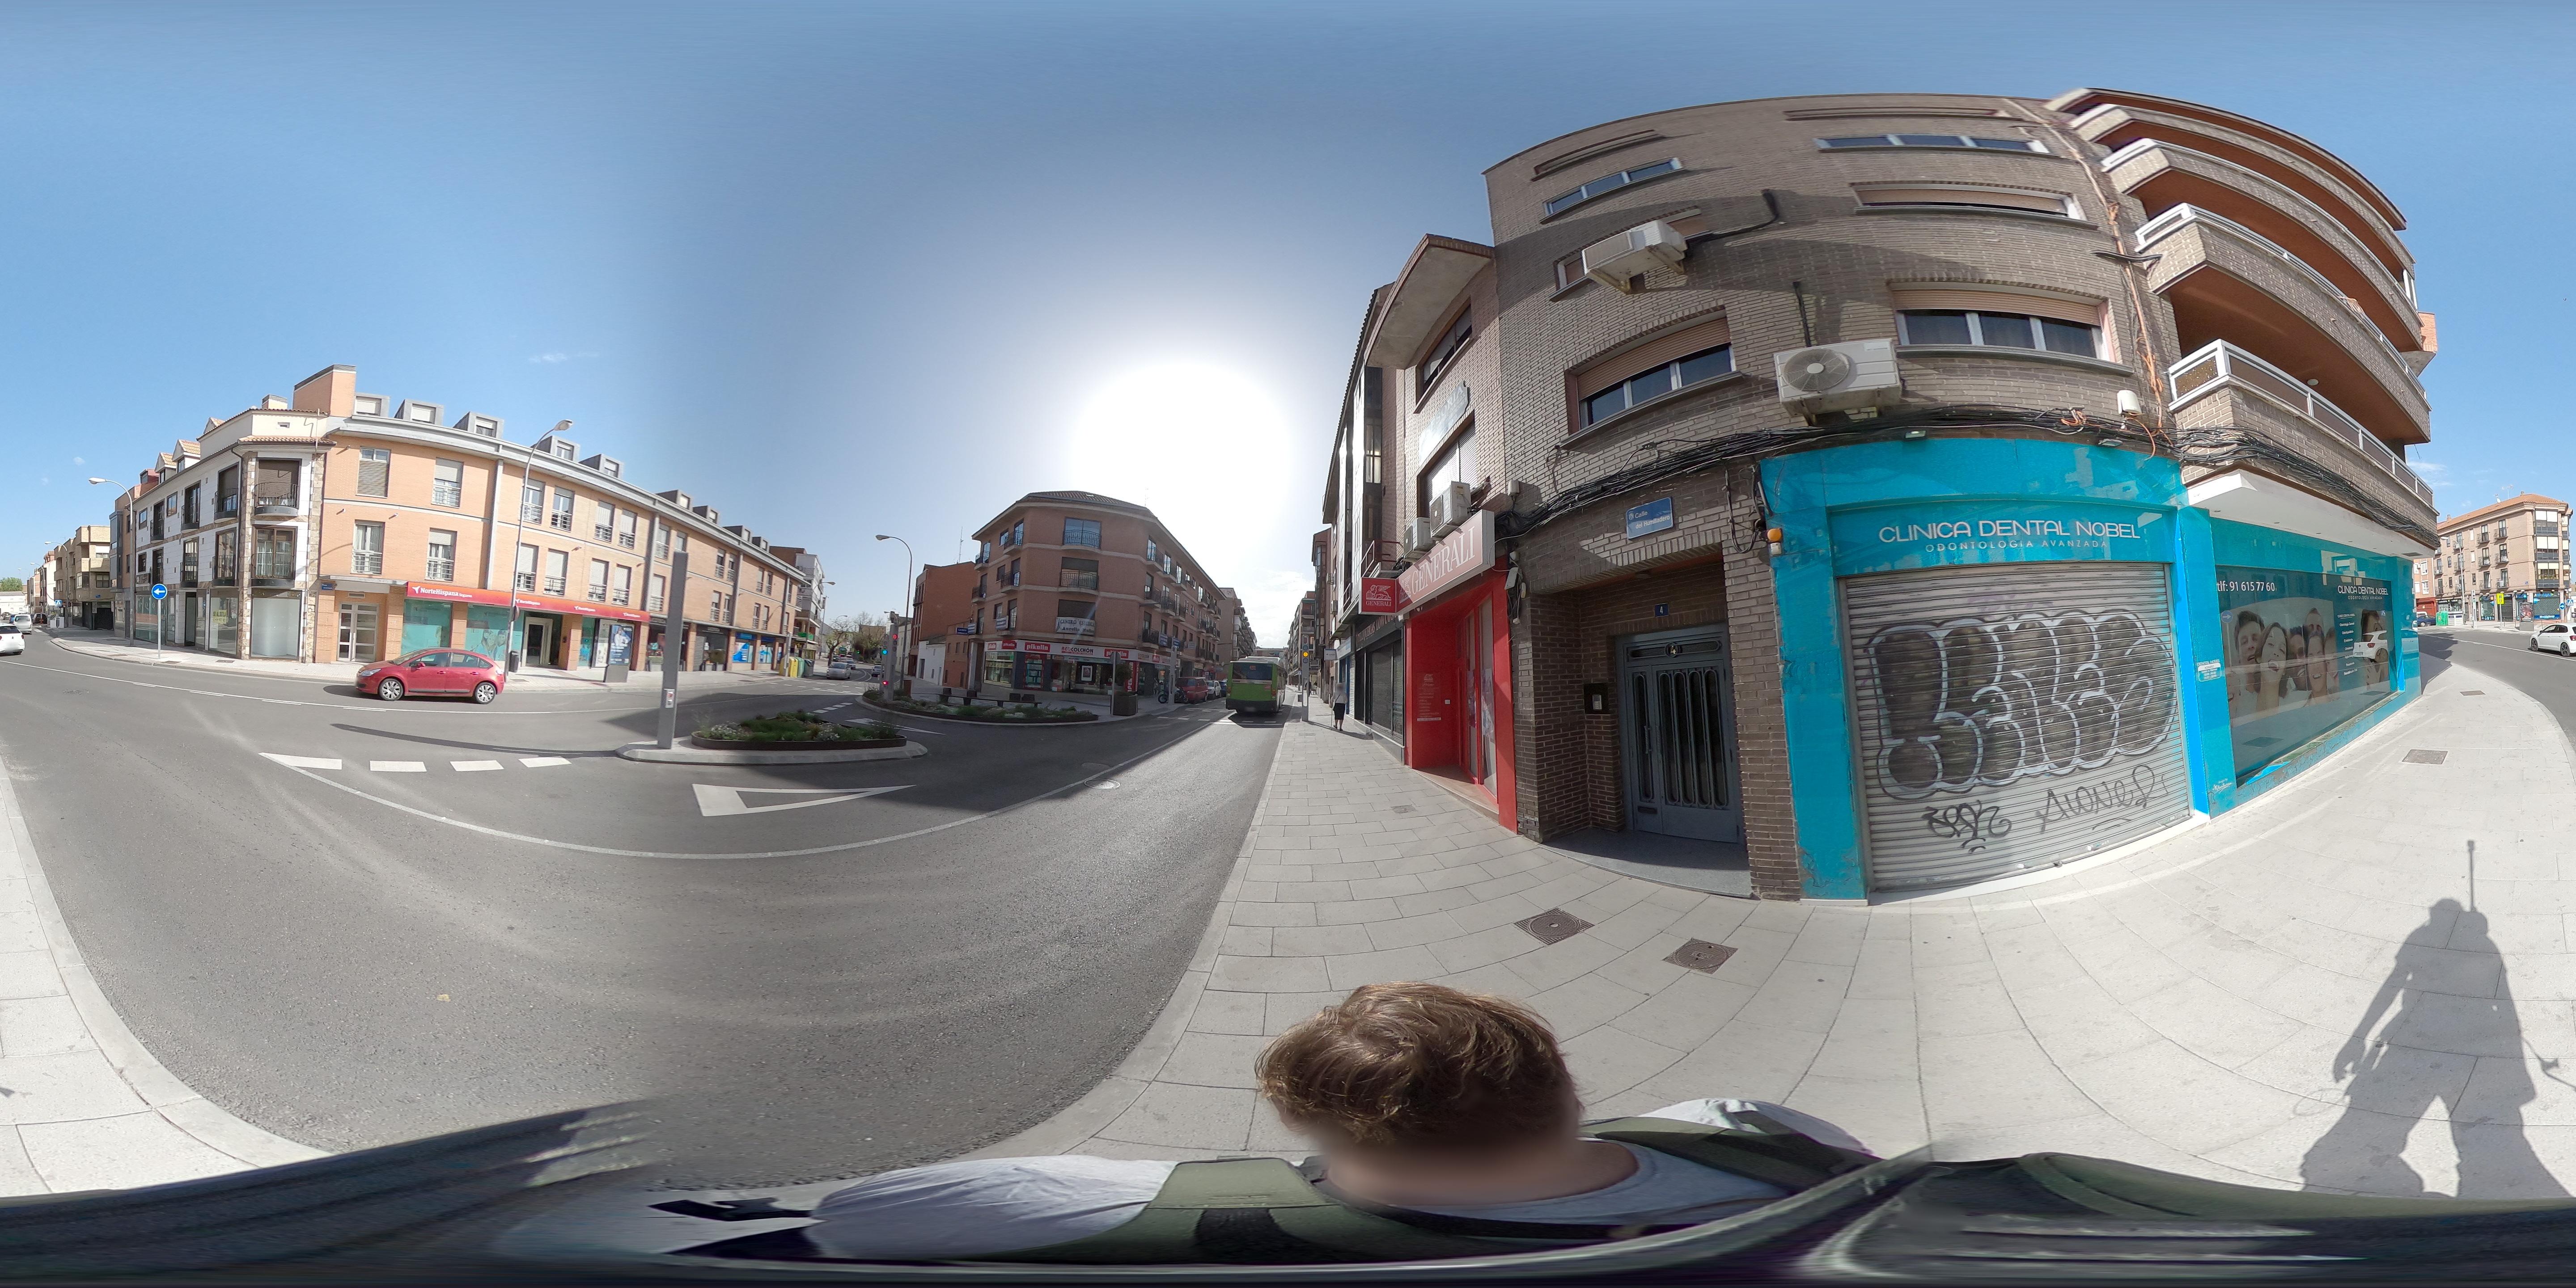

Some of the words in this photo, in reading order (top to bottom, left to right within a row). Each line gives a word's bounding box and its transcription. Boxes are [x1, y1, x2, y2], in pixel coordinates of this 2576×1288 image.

[1644, 516, 1670, 527] Humilladero
[1879, 521, 1971, 542] CLINICA
[1978, 520, 2071, 537] DENTAL
[2076, 521, 2141, 538] NOBEL
[1411, 526, 1475, 595] GENERALI
[2217, 580, 2228, 591] tlf:
[2229, 581, 2238, 591] 91
[2241, 581, 2254, 591] 615
[2256, 582, 2264, 591] 77
[2266, 582, 2275, 591] 60
[2338, 585, 2357, 594] CLINICA
[2358, 586, 2376, 594] DENTAL
[420, 587, 459, 597] NorteHispana
[1660, 606, 1663, 614] 4
[1670, 645, 1677, 654] 4
